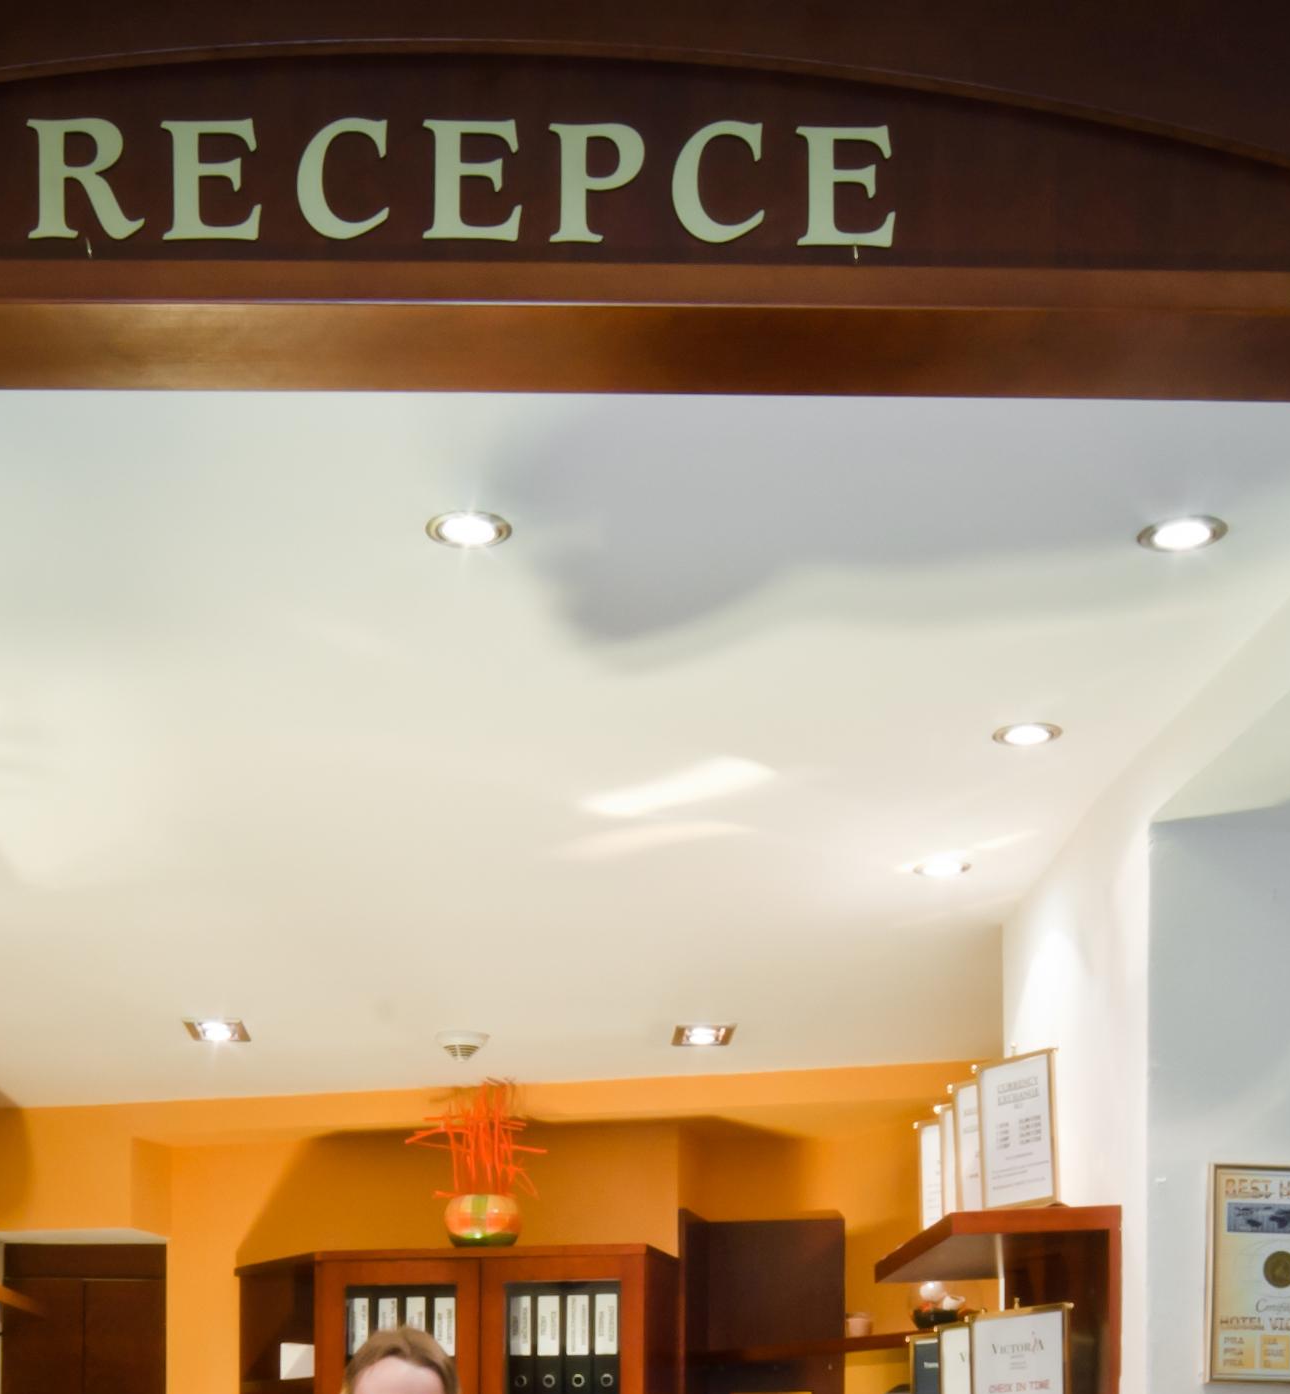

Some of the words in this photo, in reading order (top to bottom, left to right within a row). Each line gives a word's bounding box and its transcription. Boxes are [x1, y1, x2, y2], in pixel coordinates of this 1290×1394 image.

[26, 117, 896, 249] RECEPCE
[1225, 1178, 1272, 1199] BEST
[1220, 1316, 1265, 1331] HOTEL
[989, 1382, 1013, 1393] CHECK
[1016, 1381, 1027, 1392] IN
[1029, 1379, 1051, 1391] TIME
